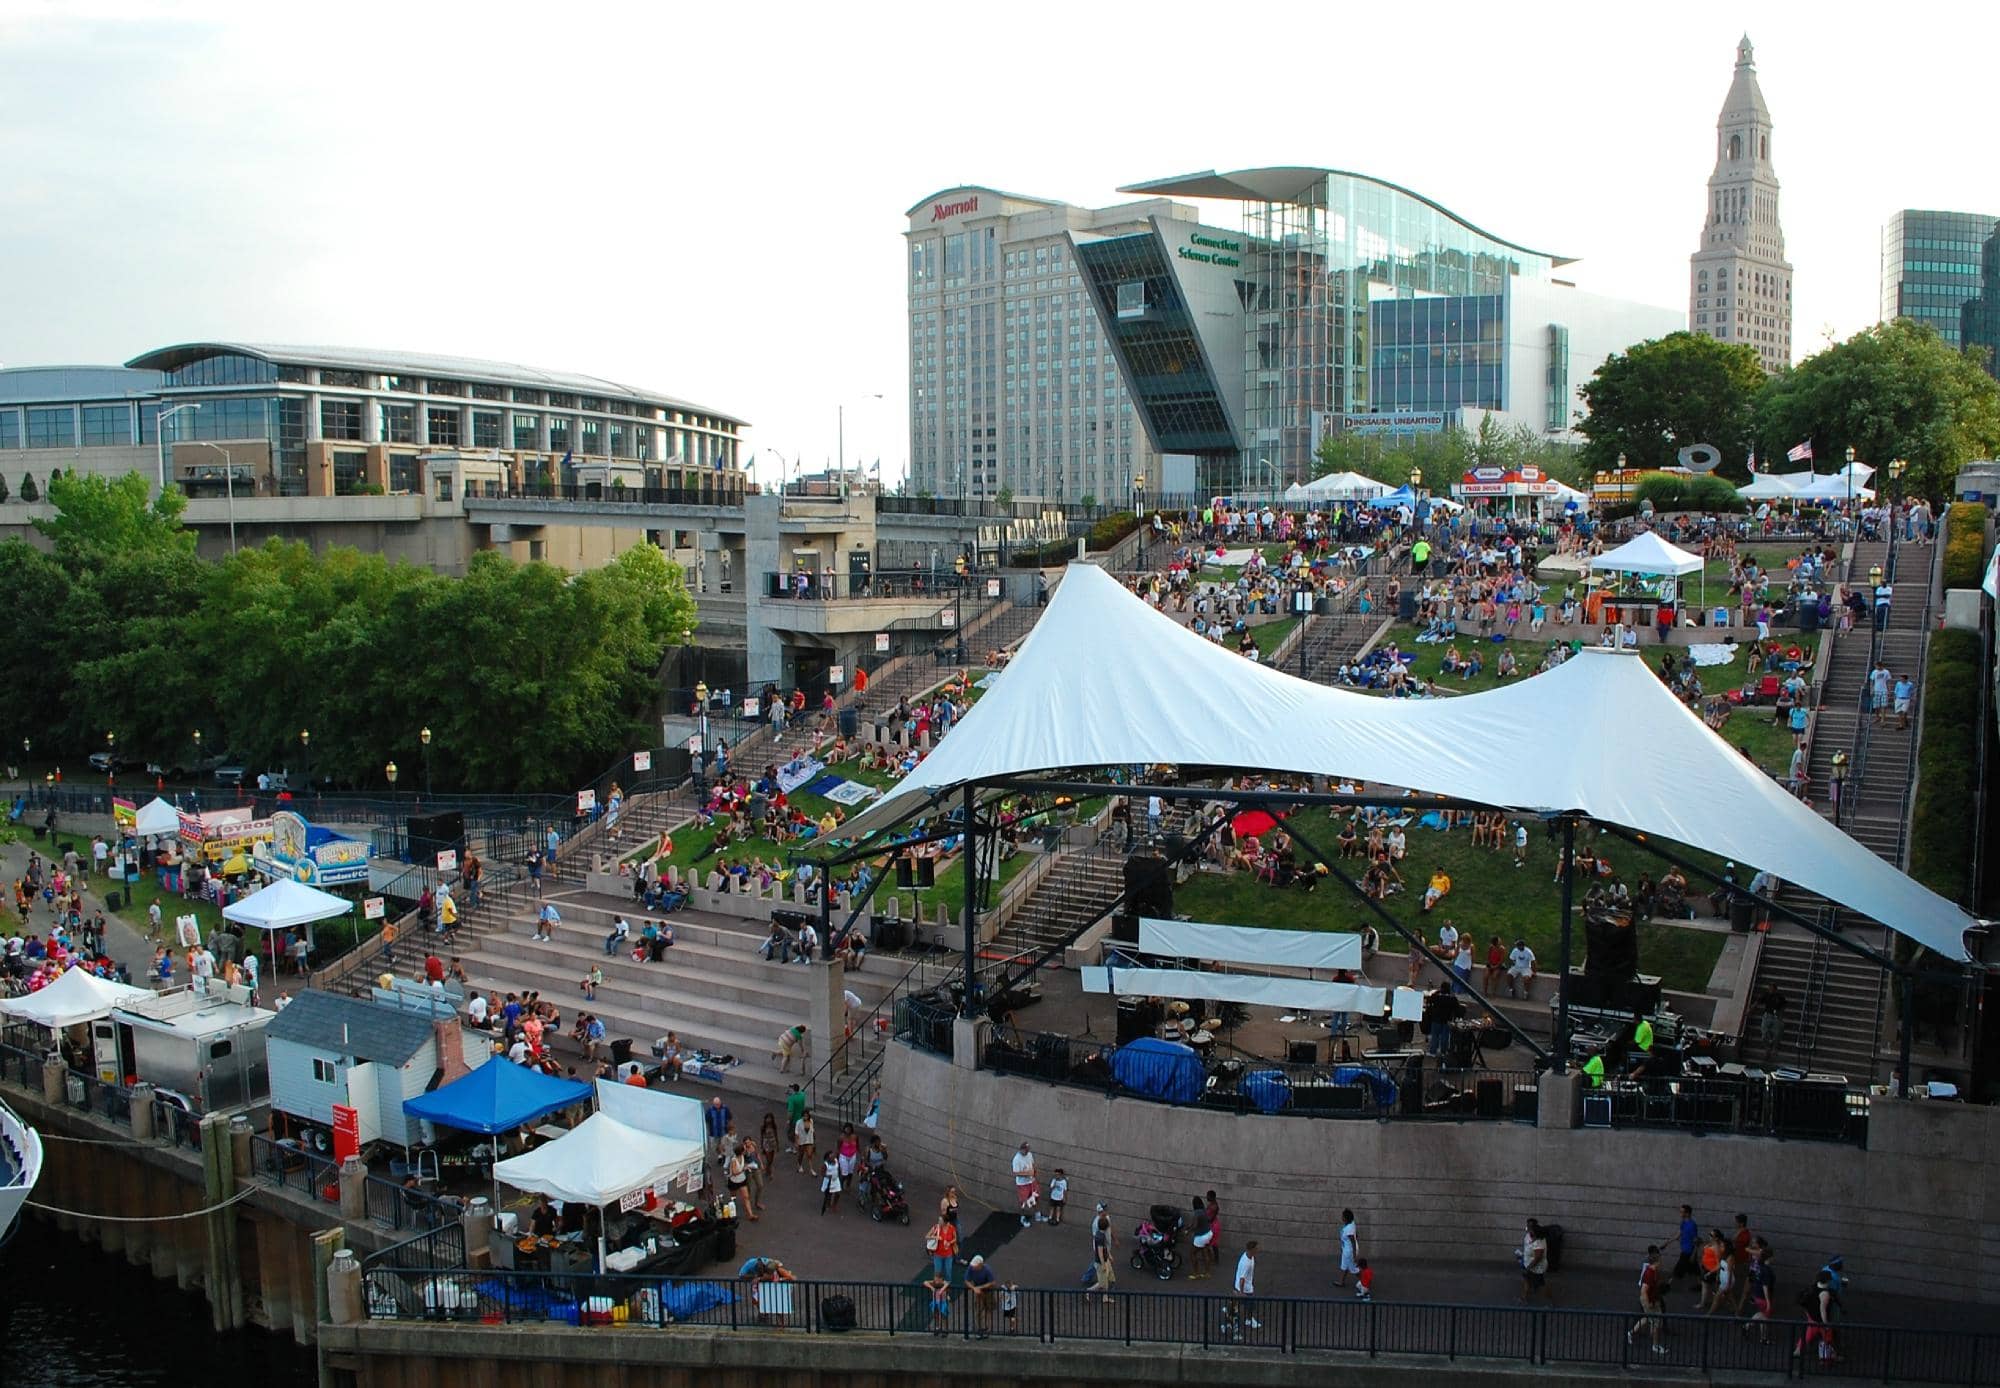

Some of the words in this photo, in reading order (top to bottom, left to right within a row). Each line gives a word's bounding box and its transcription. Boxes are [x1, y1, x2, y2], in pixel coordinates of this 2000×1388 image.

[931, 196, 978, 223] Marriott
[1190, 232, 1239, 252] Connecticut
[1178, 246, 1210, 263] Science
[1211, 253, 1239, 268] Center
[1394, 416, 1441, 426] UNEARTHED
[223, 821, 273, 833] GYROS
[207, 837, 240, 849] LEMONADE
[622, 1190, 642, 1203] CORN
[622, 1198, 642, 1210] DOGS
